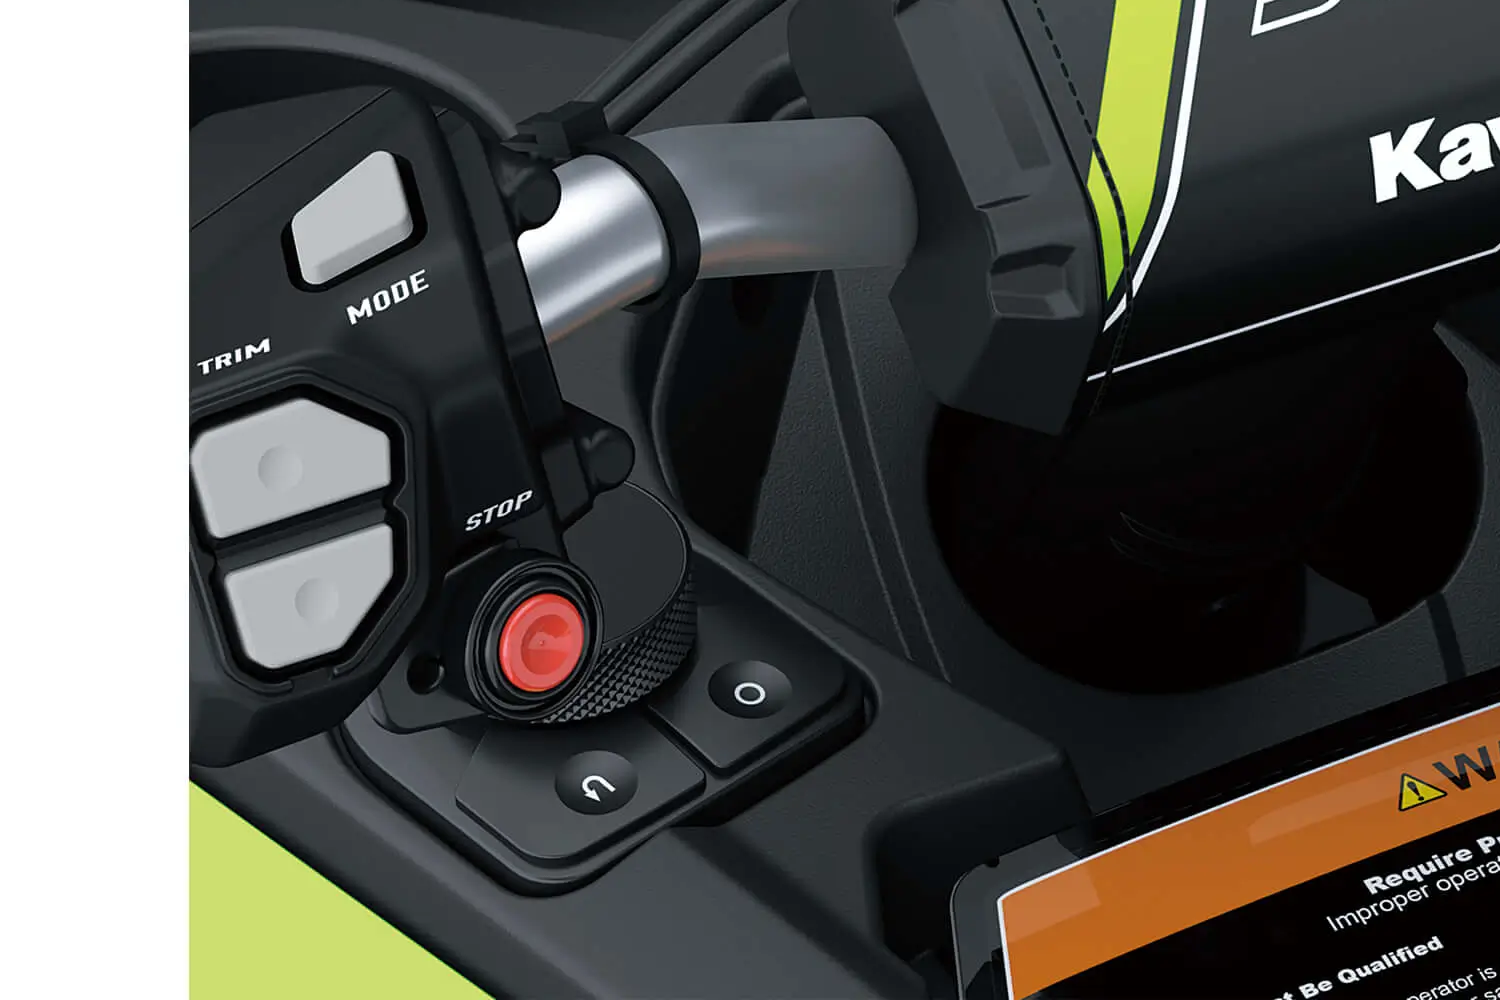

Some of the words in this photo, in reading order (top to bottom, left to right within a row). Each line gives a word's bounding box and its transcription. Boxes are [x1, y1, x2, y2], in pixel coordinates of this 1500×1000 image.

[346, 268, 430, 325] MODE
[196, 338, 271, 375] TRIM
[465, 490, 533, 531] STOP
[1363, 849, 1473, 895] Require
[1326, 885, 1429, 931] Improper
[1299, 980, 1333, 999] Be
[1337, 936, 1444, 984] Qualified
[1406, 974, 1474, 1000] erator
[1477, 967, 1497, 981] is
